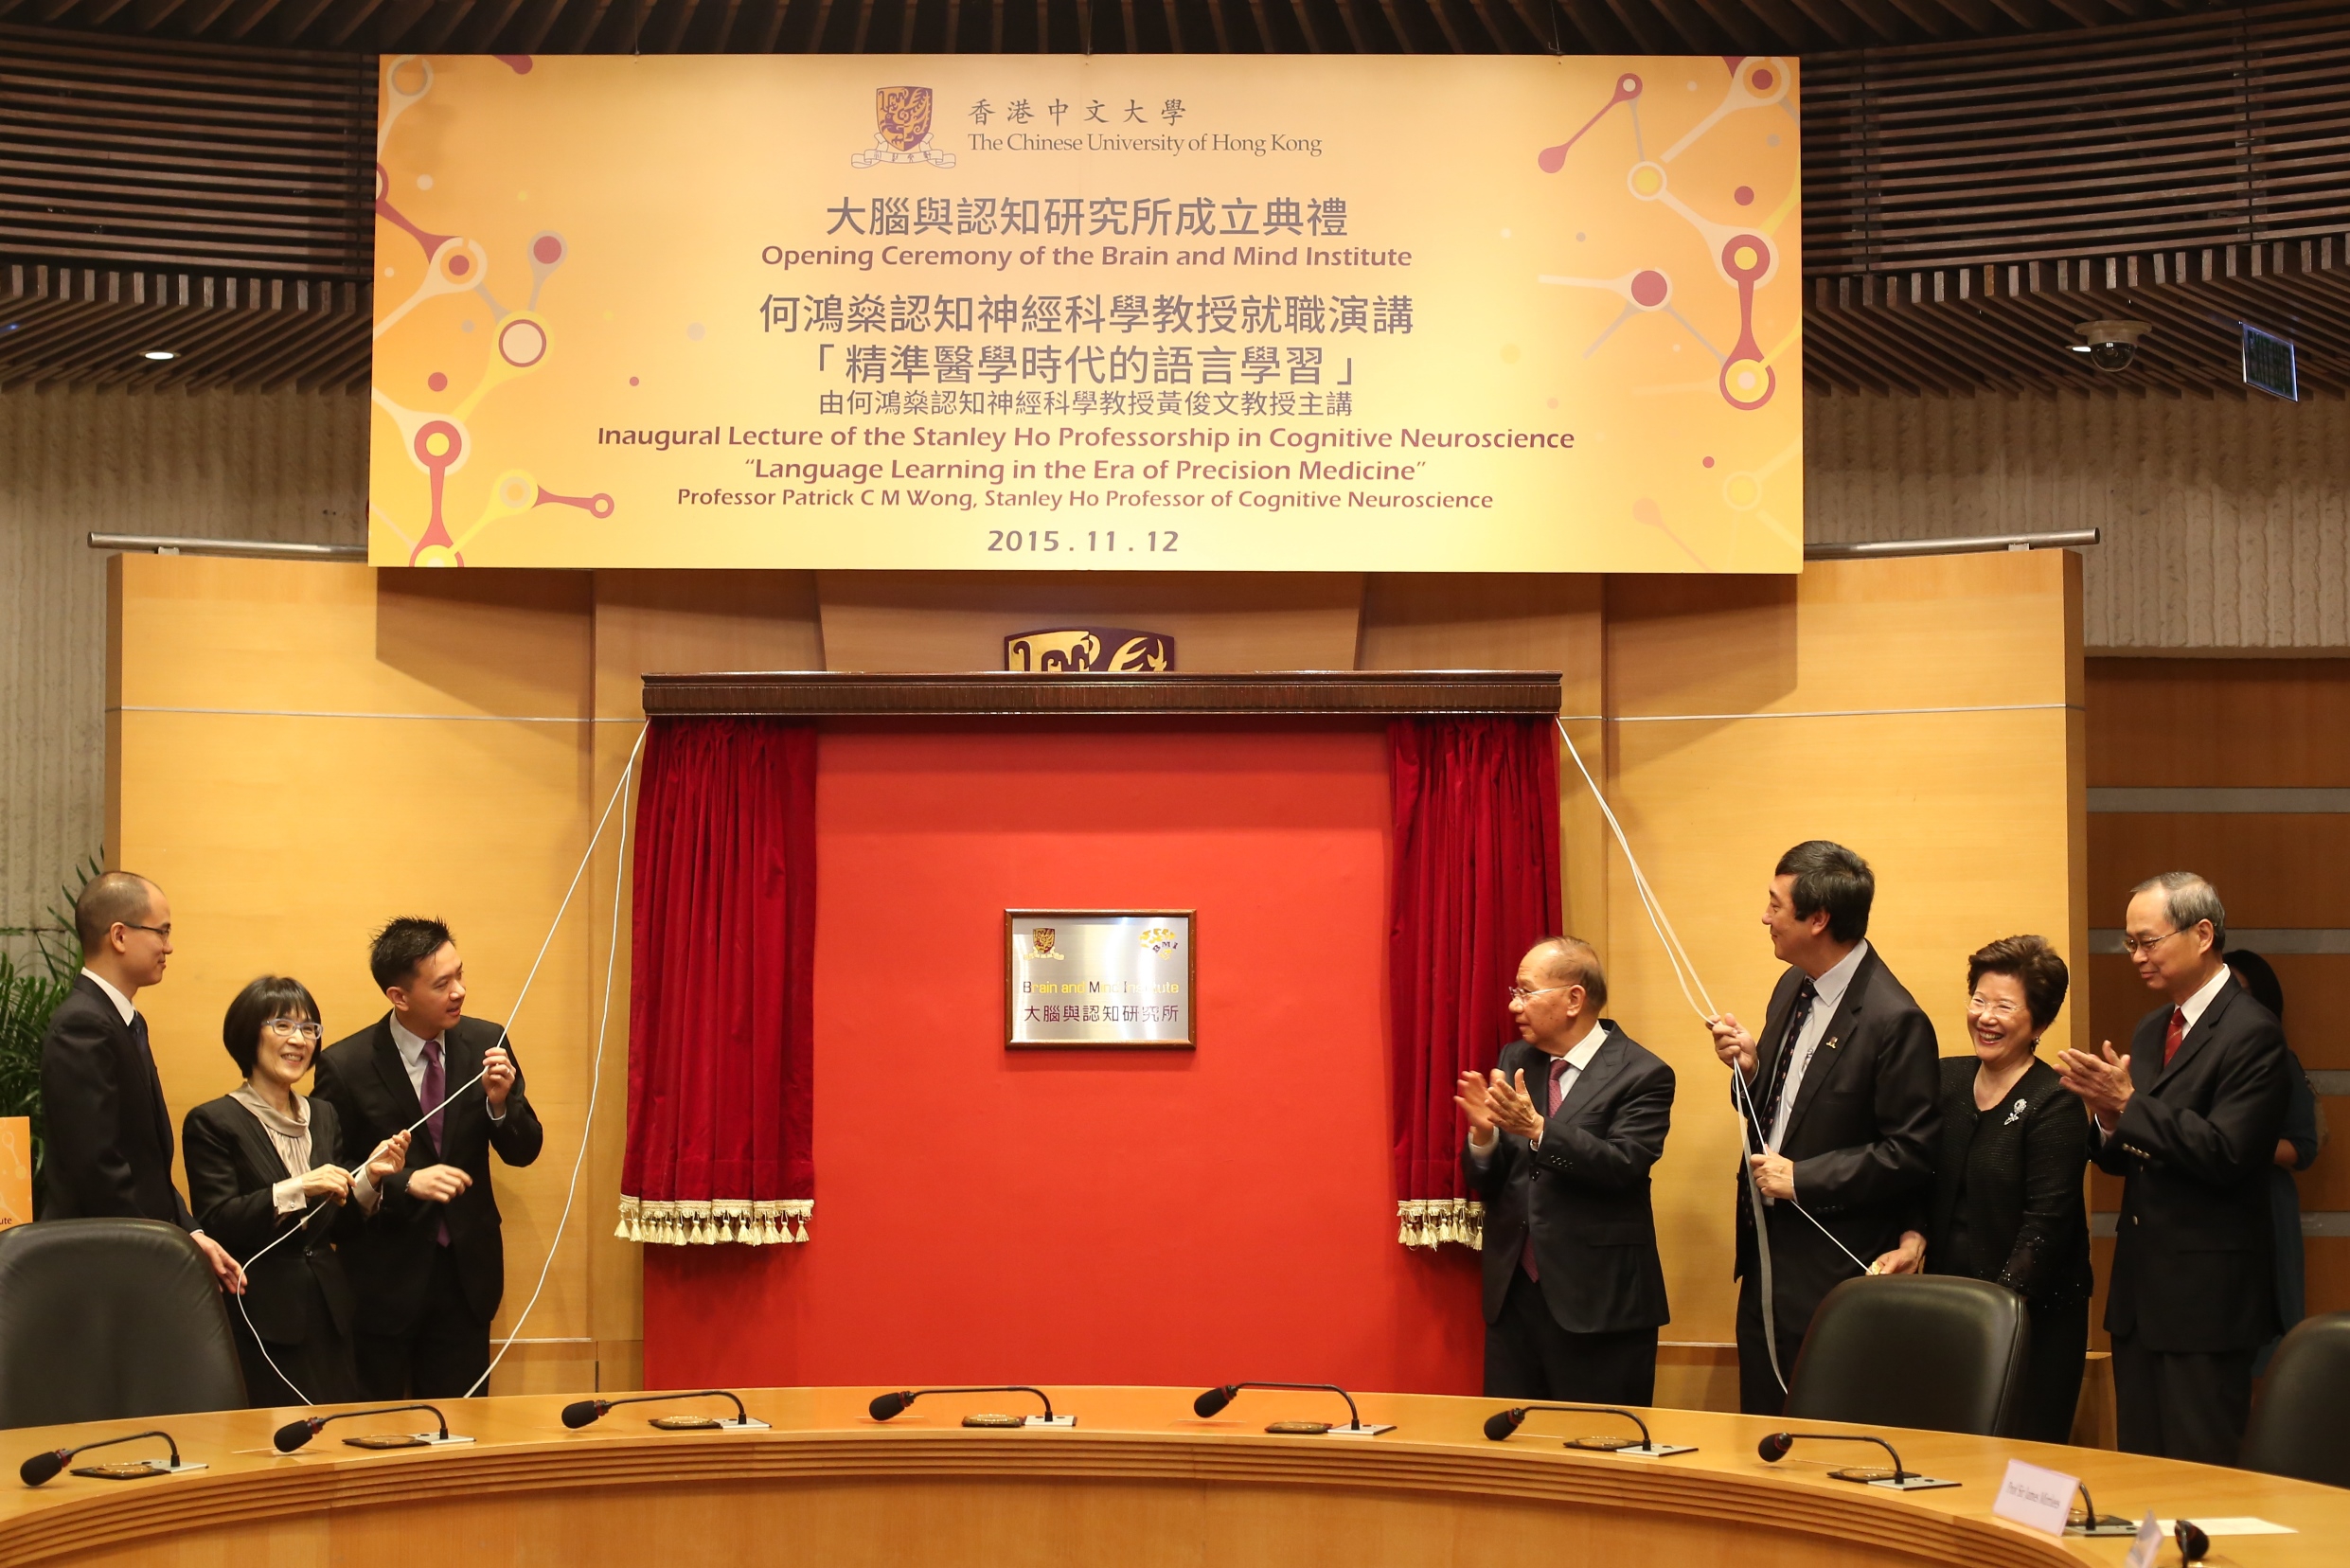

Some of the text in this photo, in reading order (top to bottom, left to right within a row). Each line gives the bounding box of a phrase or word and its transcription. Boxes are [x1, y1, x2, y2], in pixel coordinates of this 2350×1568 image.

[968, 98, 1186, 127] 香港中文大學
[967, 133, 1323, 157] The Chinese University of Hong Kong
[826, 196, 1348, 237] 大腦與認知研究所成立典禮
[761, 245, 1413, 272] Opening Ceremony of the Brain and Mind Institute
[758, 293, 1414, 335] 何鴻燊認知神經科學教授就職演講
[820, 389, 1353, 417] 由何鴻燊認知神經科學教授黃俊文教授主講
[597, 425, 1575, 454] Inaugural Lecture of the Stanley Ho Professorship in Cognitive Neuroscience
[891, 459, 1005, 486] Learning
[1012, 459, 1036, 479] in
[1043, 459, 1087, 480] the
[1094, 459, 1134, 480] Era
[1142, 459, 1170, 480] of
[1176, 460, 1291, 480] Precision
[678, 488, 1494, 512] Professor Patrick C M Wong, Stanley Ho Professor of Cognitive Neuroscience
[1152, 941, 1179, 953] BMI
[1023, 981, 1058, 993] Brain
[1061, 981, 1086, 993] and
[1123, 981, 1180, 993] Instute
[1024, 1005, 1180, 1023] 大腦與認知研究所
